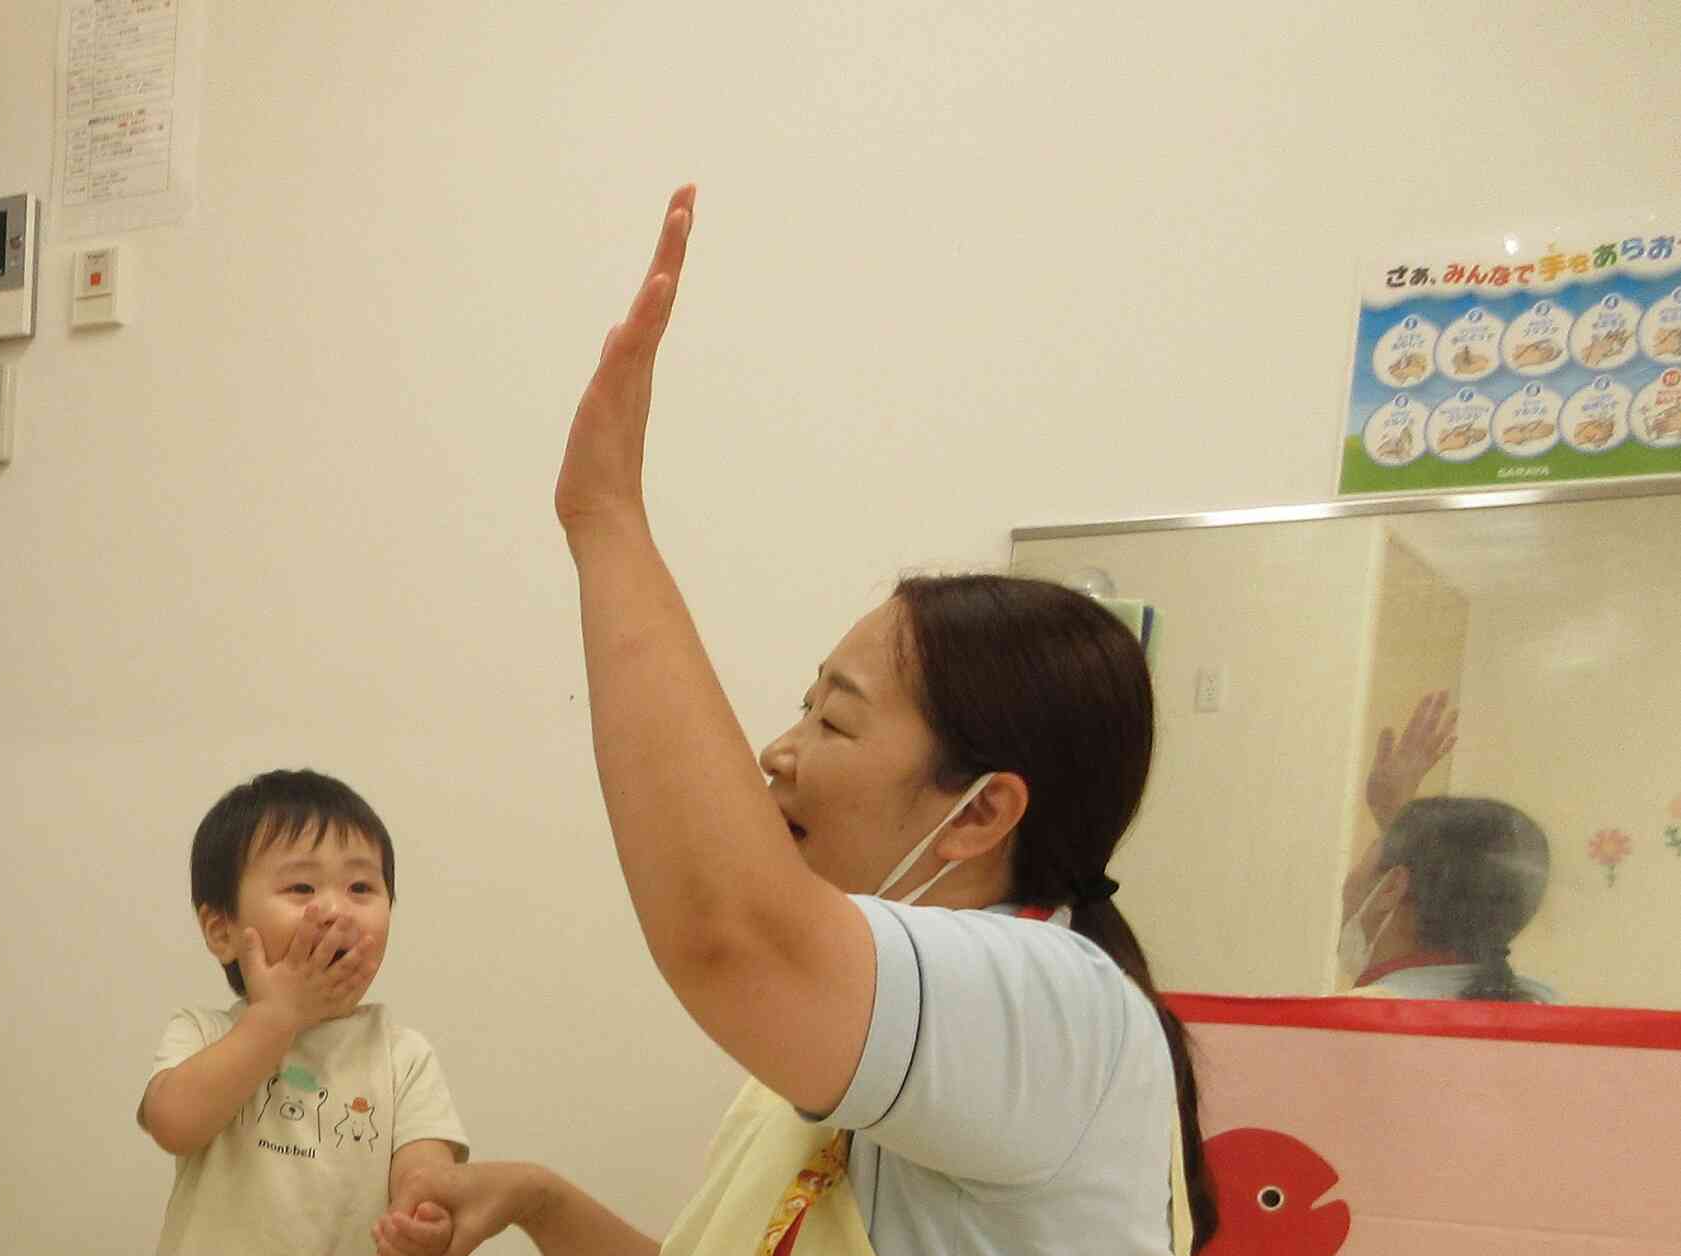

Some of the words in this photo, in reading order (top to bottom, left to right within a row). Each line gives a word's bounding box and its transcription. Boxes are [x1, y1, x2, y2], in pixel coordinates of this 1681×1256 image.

[1386, 236, 1681, 287] さあ、みんなで手をあらお
